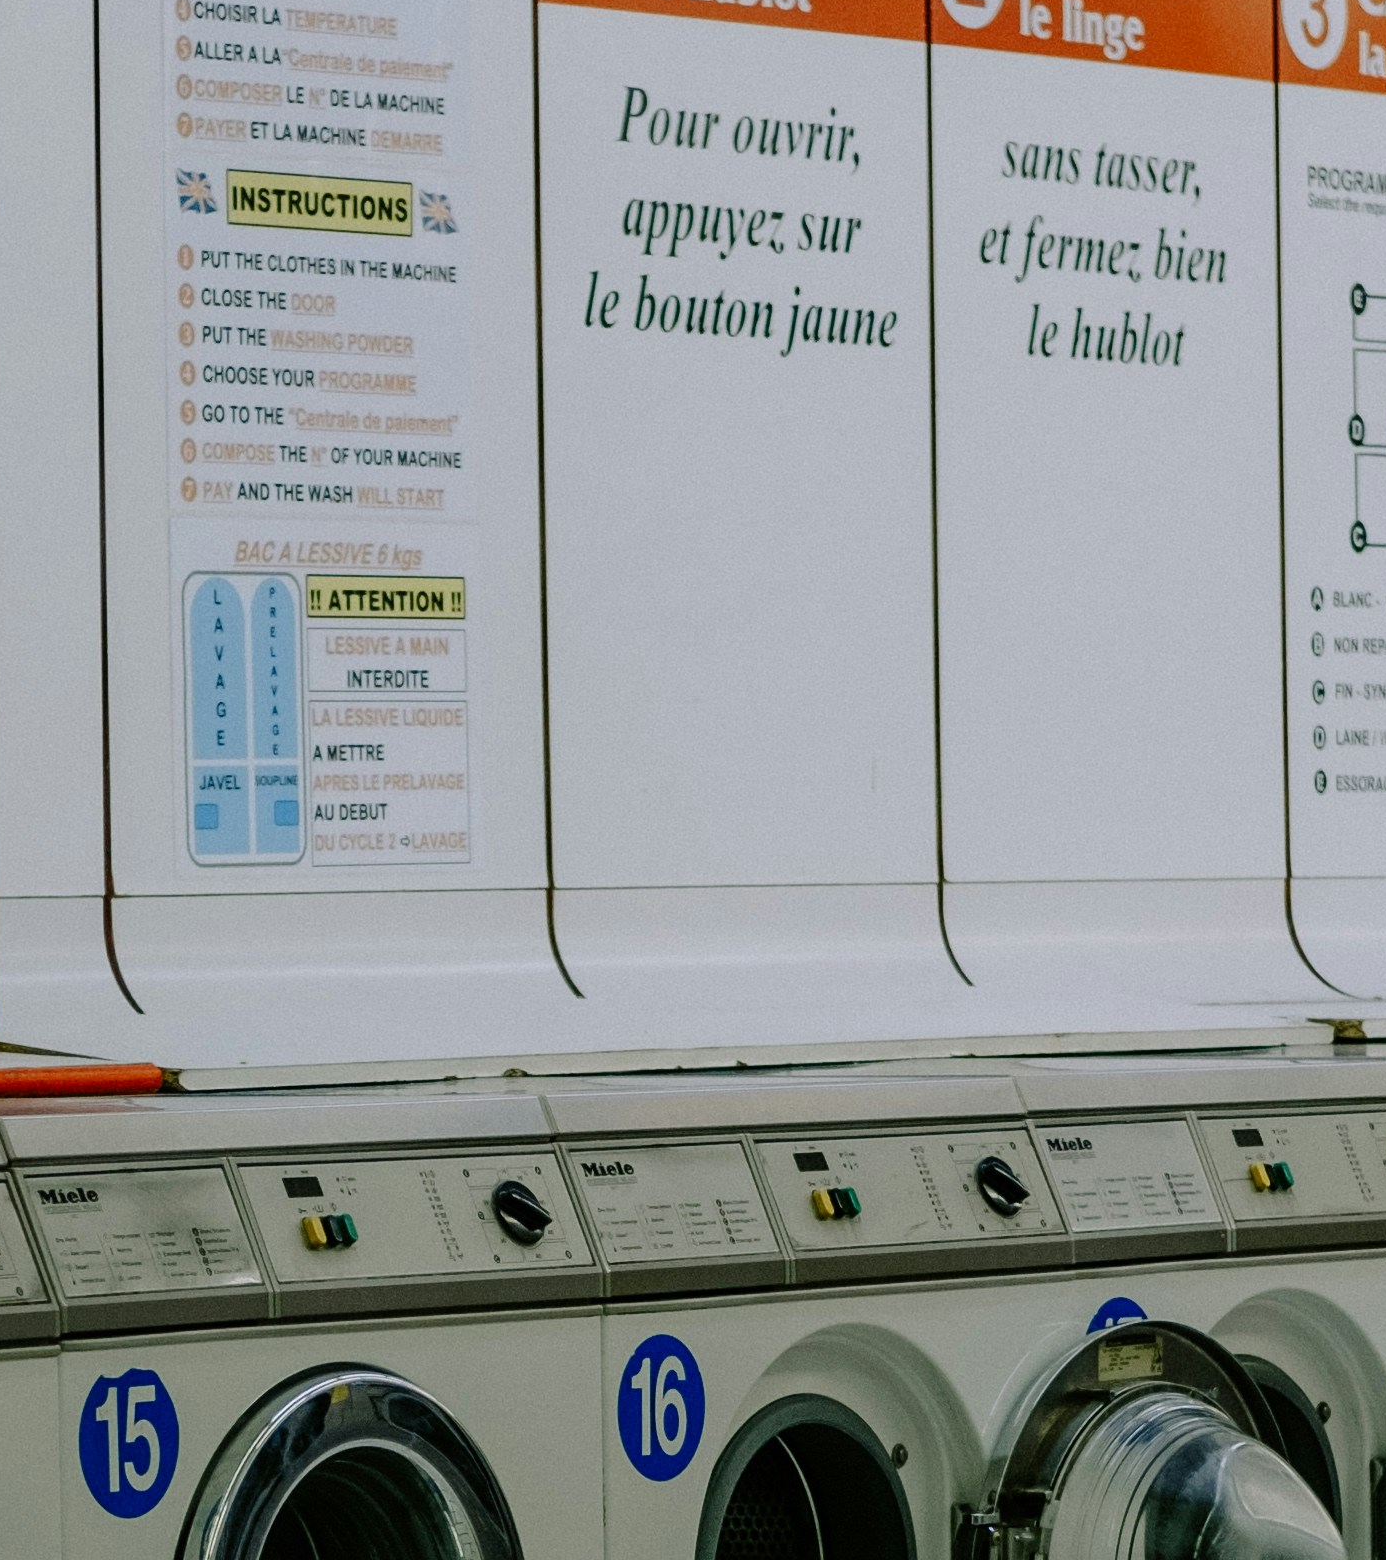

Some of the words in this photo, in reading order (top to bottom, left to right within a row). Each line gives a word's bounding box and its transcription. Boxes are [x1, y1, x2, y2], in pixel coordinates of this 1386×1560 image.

[617, 86, 719, 151] Pour
[733, 107, 862, 174] ouvrir,
[1002, 140, 1081, 184] sans
[1094, 143, 1201, 202] tasser,
[232, 186, 408, 223] INSTRUCTIONS
[623, 197, 786, 261] appuyez
[798, 211, 862, 254] sur
[201, 250, 230, 269] PUT
[235, 253, 263, 271] THE
[267, 255, 336, 275] CLOTHES
[341, 260, 355, 276] IN
[359, 260, 388, 278] THE
[392, 262, 457, 283] MACHINE
[979, 221, 1012, 264] et
[1015, 214, 1141, 283] fermez
[1155, 228, 1227, 283] bien
[583, 271, 619, 329] le
[635, 274, 773, 338] bouton
[780, 286, 898, 357] jaune
[1027, 304, 1058, 357] le
[1071, 306, 1184, 366] hublot
[329, 590, 444, 613] ATTENTION
[347, 670, 429, 689] INTERDITE
[199, 775, 241, 791] JAVEL
[581, 1161, 634, 1177] Miele
[1047, 1137, 1093, 1152] Miele
[37, 1188, 99, 1204] Miele
[630, 1354, 687, 1456] 16
[97, 1385, 161, 1494] 15
